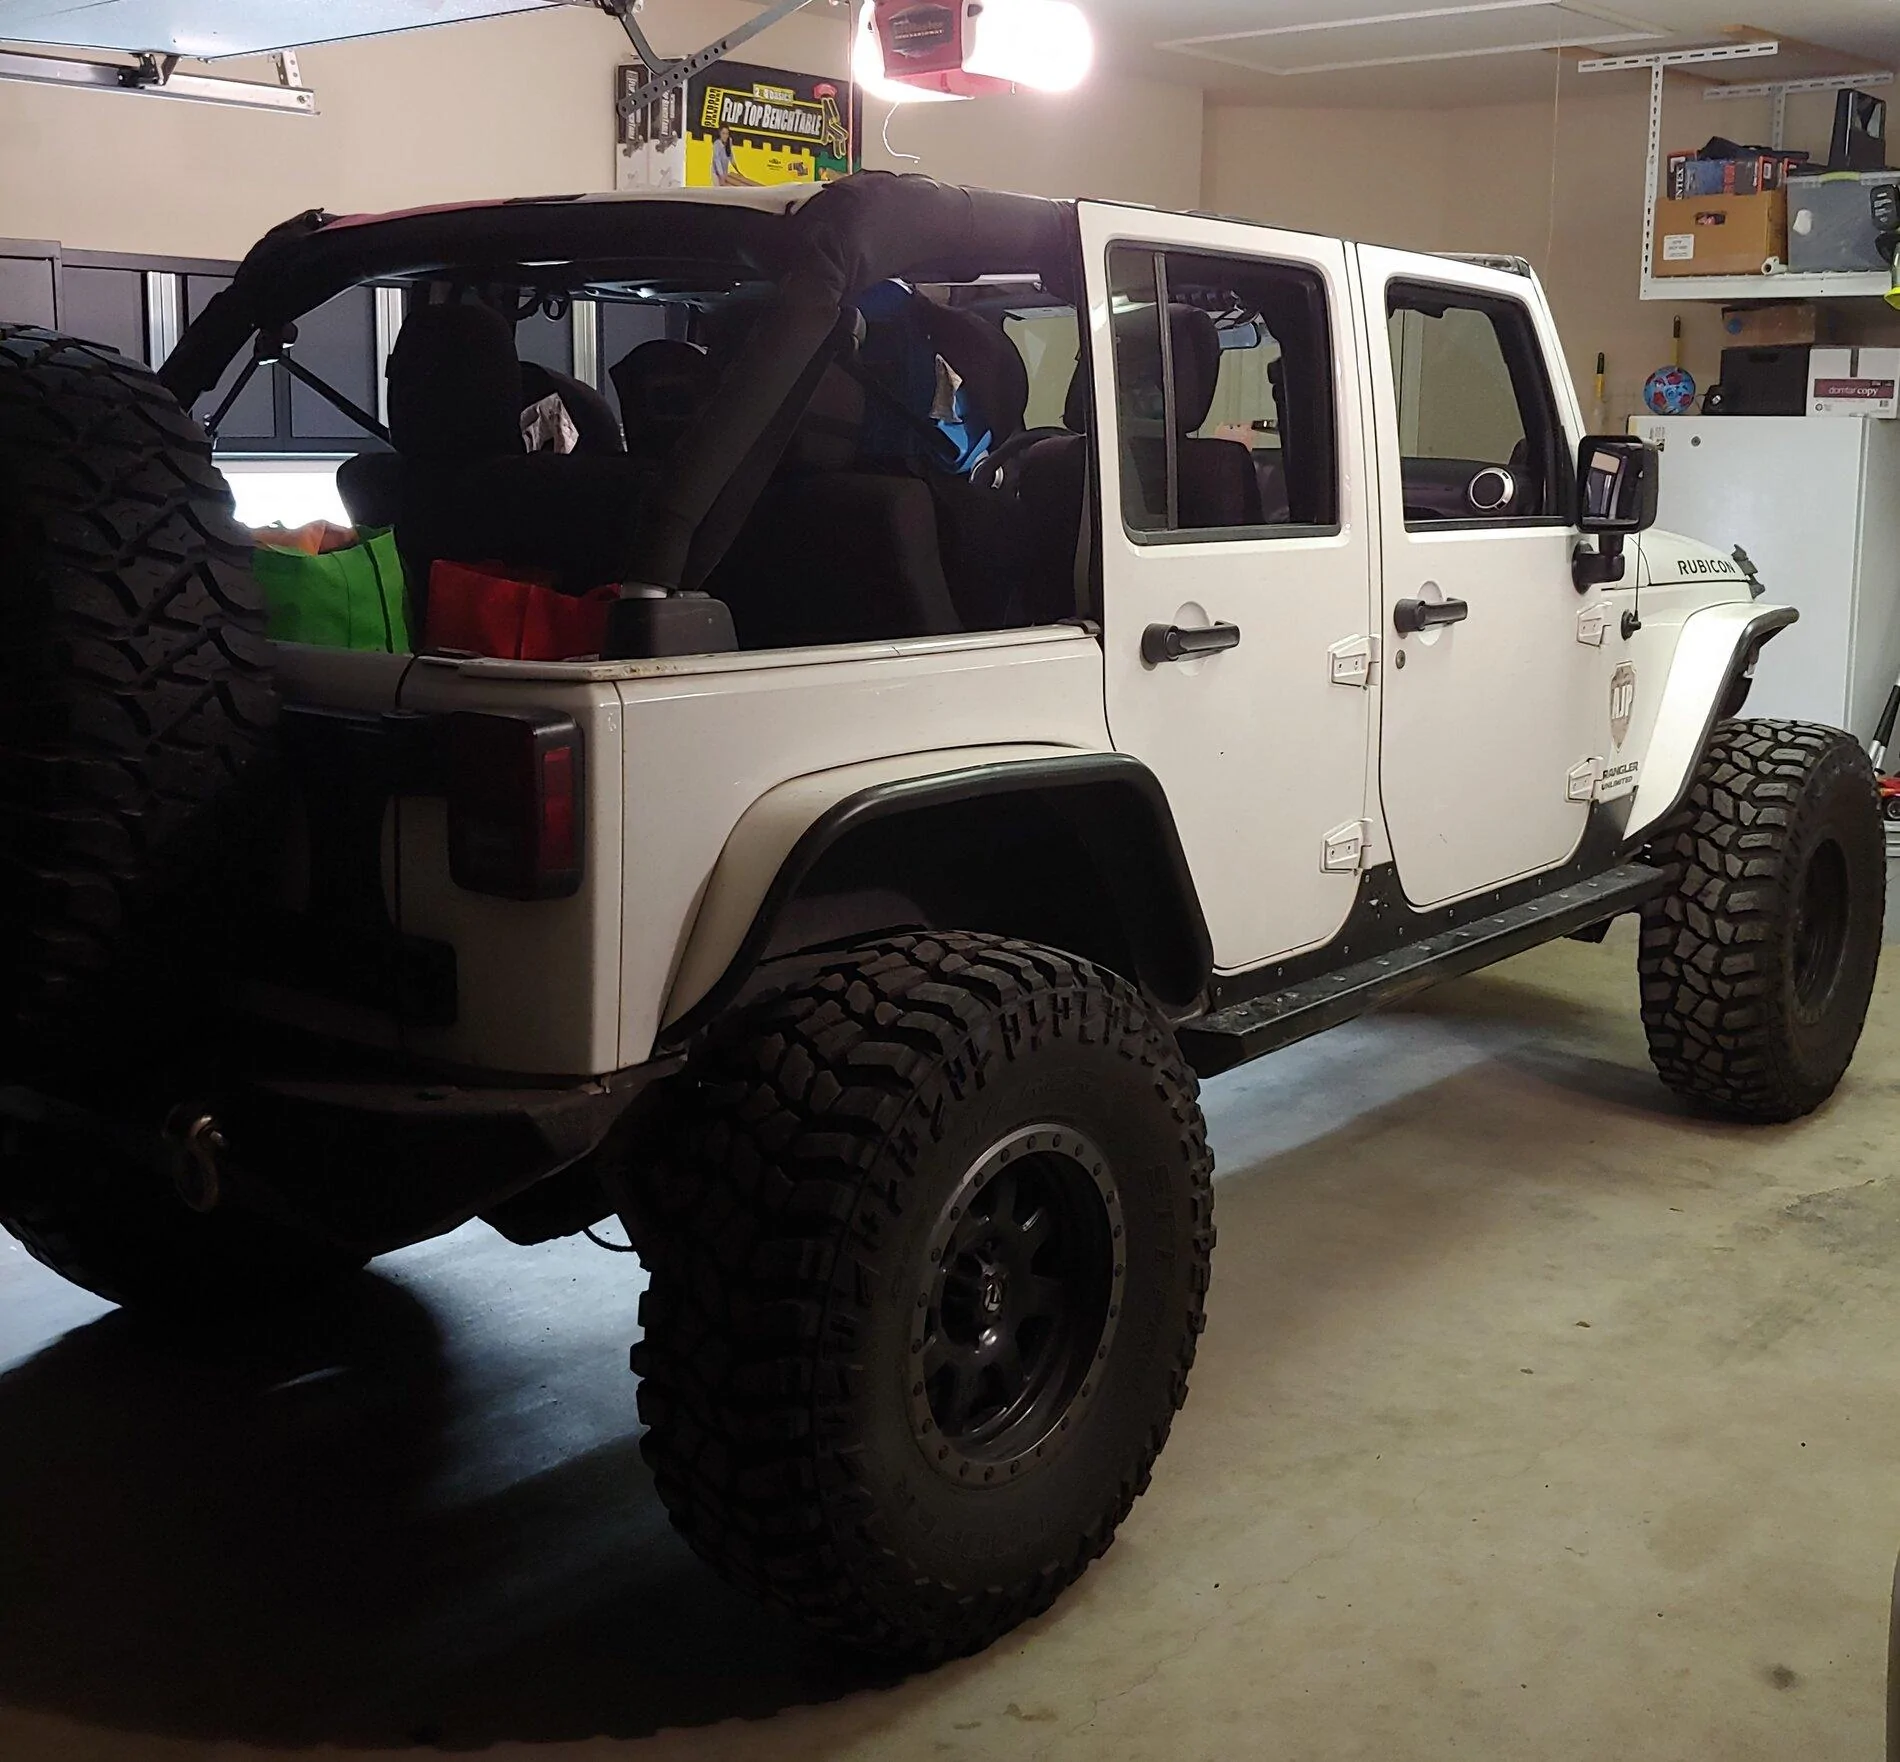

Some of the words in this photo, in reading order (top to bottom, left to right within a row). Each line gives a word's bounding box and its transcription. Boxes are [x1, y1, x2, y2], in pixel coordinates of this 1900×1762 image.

[721, 97, 744, 124] FLIP
[743, 100, 764, 127] TOP
[1856, 387, 1879, 397] copy
[1677, 559, 1736, 575] RUBICON
[1602, 761, 1639, 780] RANGLER
